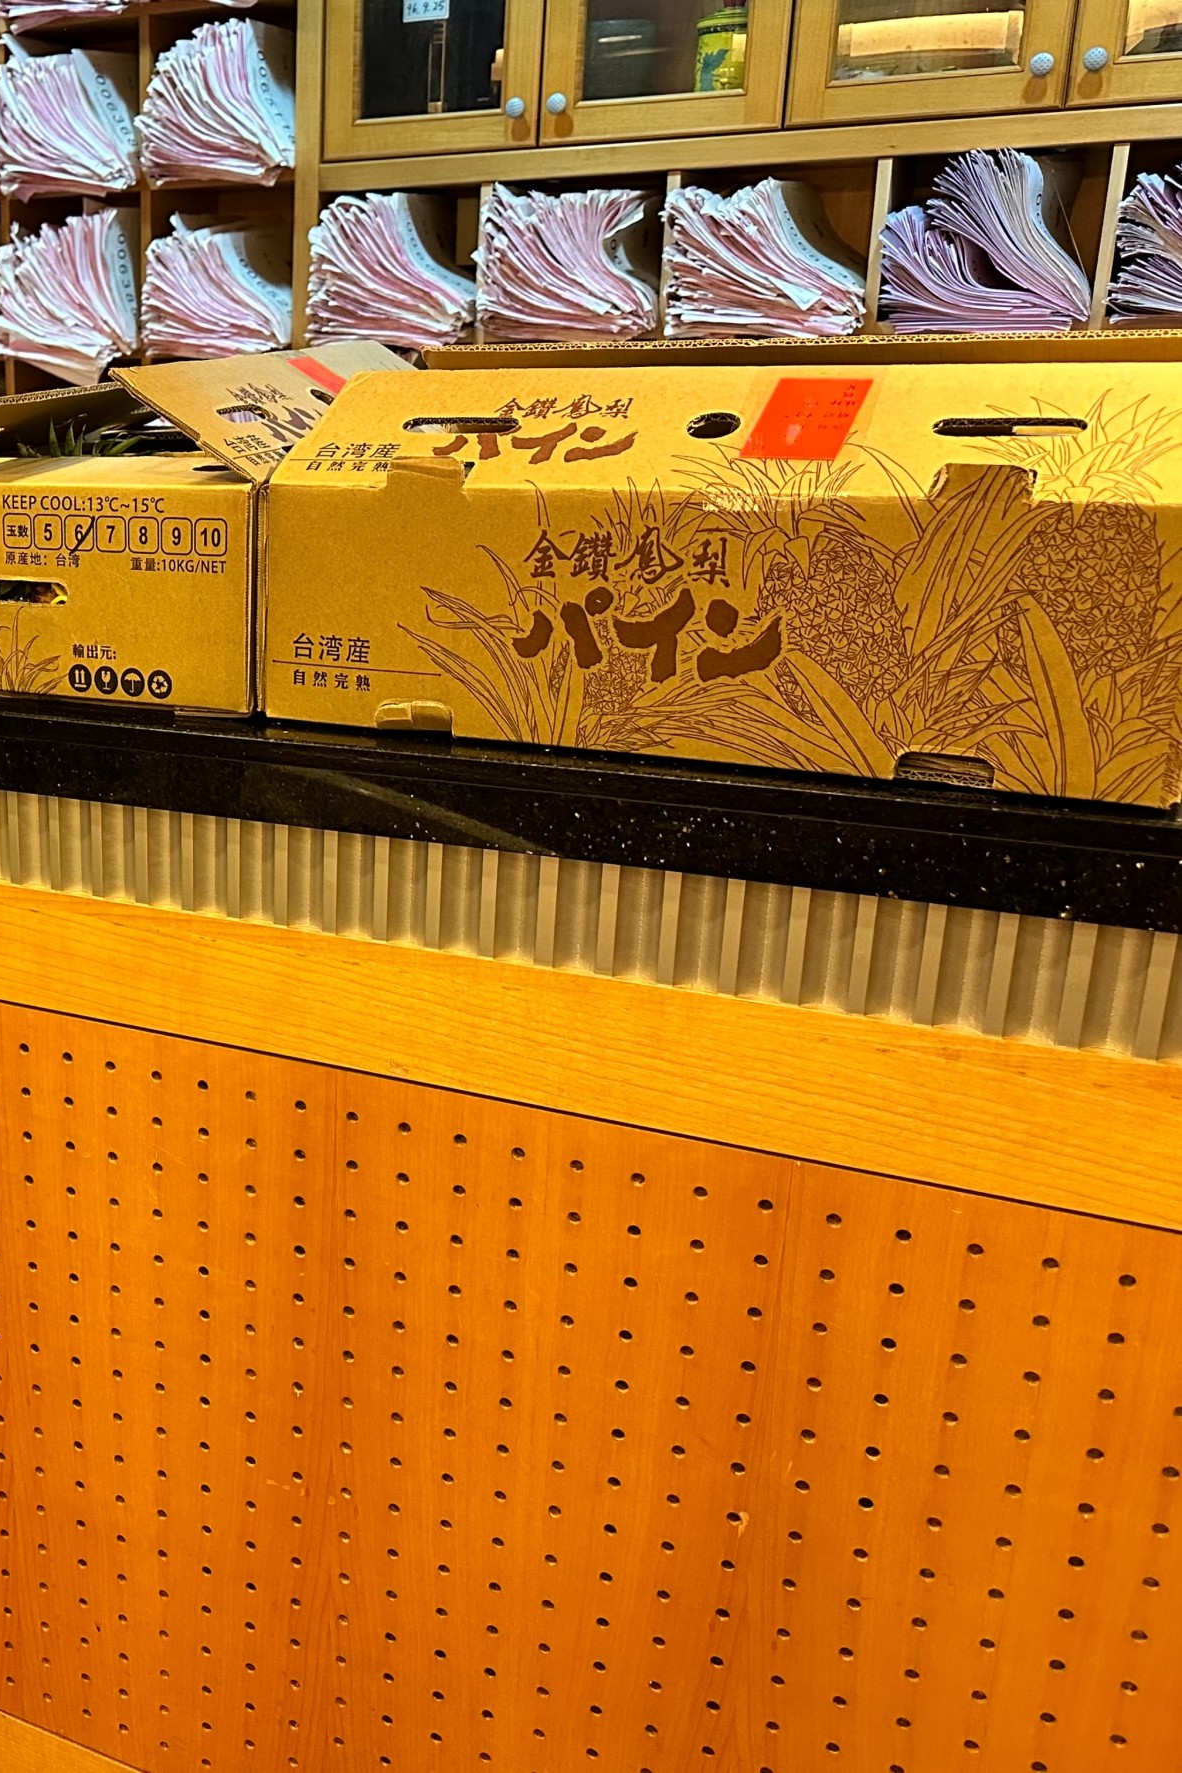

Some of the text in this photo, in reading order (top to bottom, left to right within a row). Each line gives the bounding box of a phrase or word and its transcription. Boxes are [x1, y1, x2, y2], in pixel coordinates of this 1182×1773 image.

[314, 442, 401, 459] 台湾産
[2, 494, 37, 511] KEEP
[6, 522, 221, 548] 玉数 5 6 7 8 9 10
[523, 525, 731, 589] 金鑽鳳梨
[292, 632, 372, 664] 台湾産
[511, 586, 785, 685] パイン
[292, 669, 372, 693] 自然完熟
